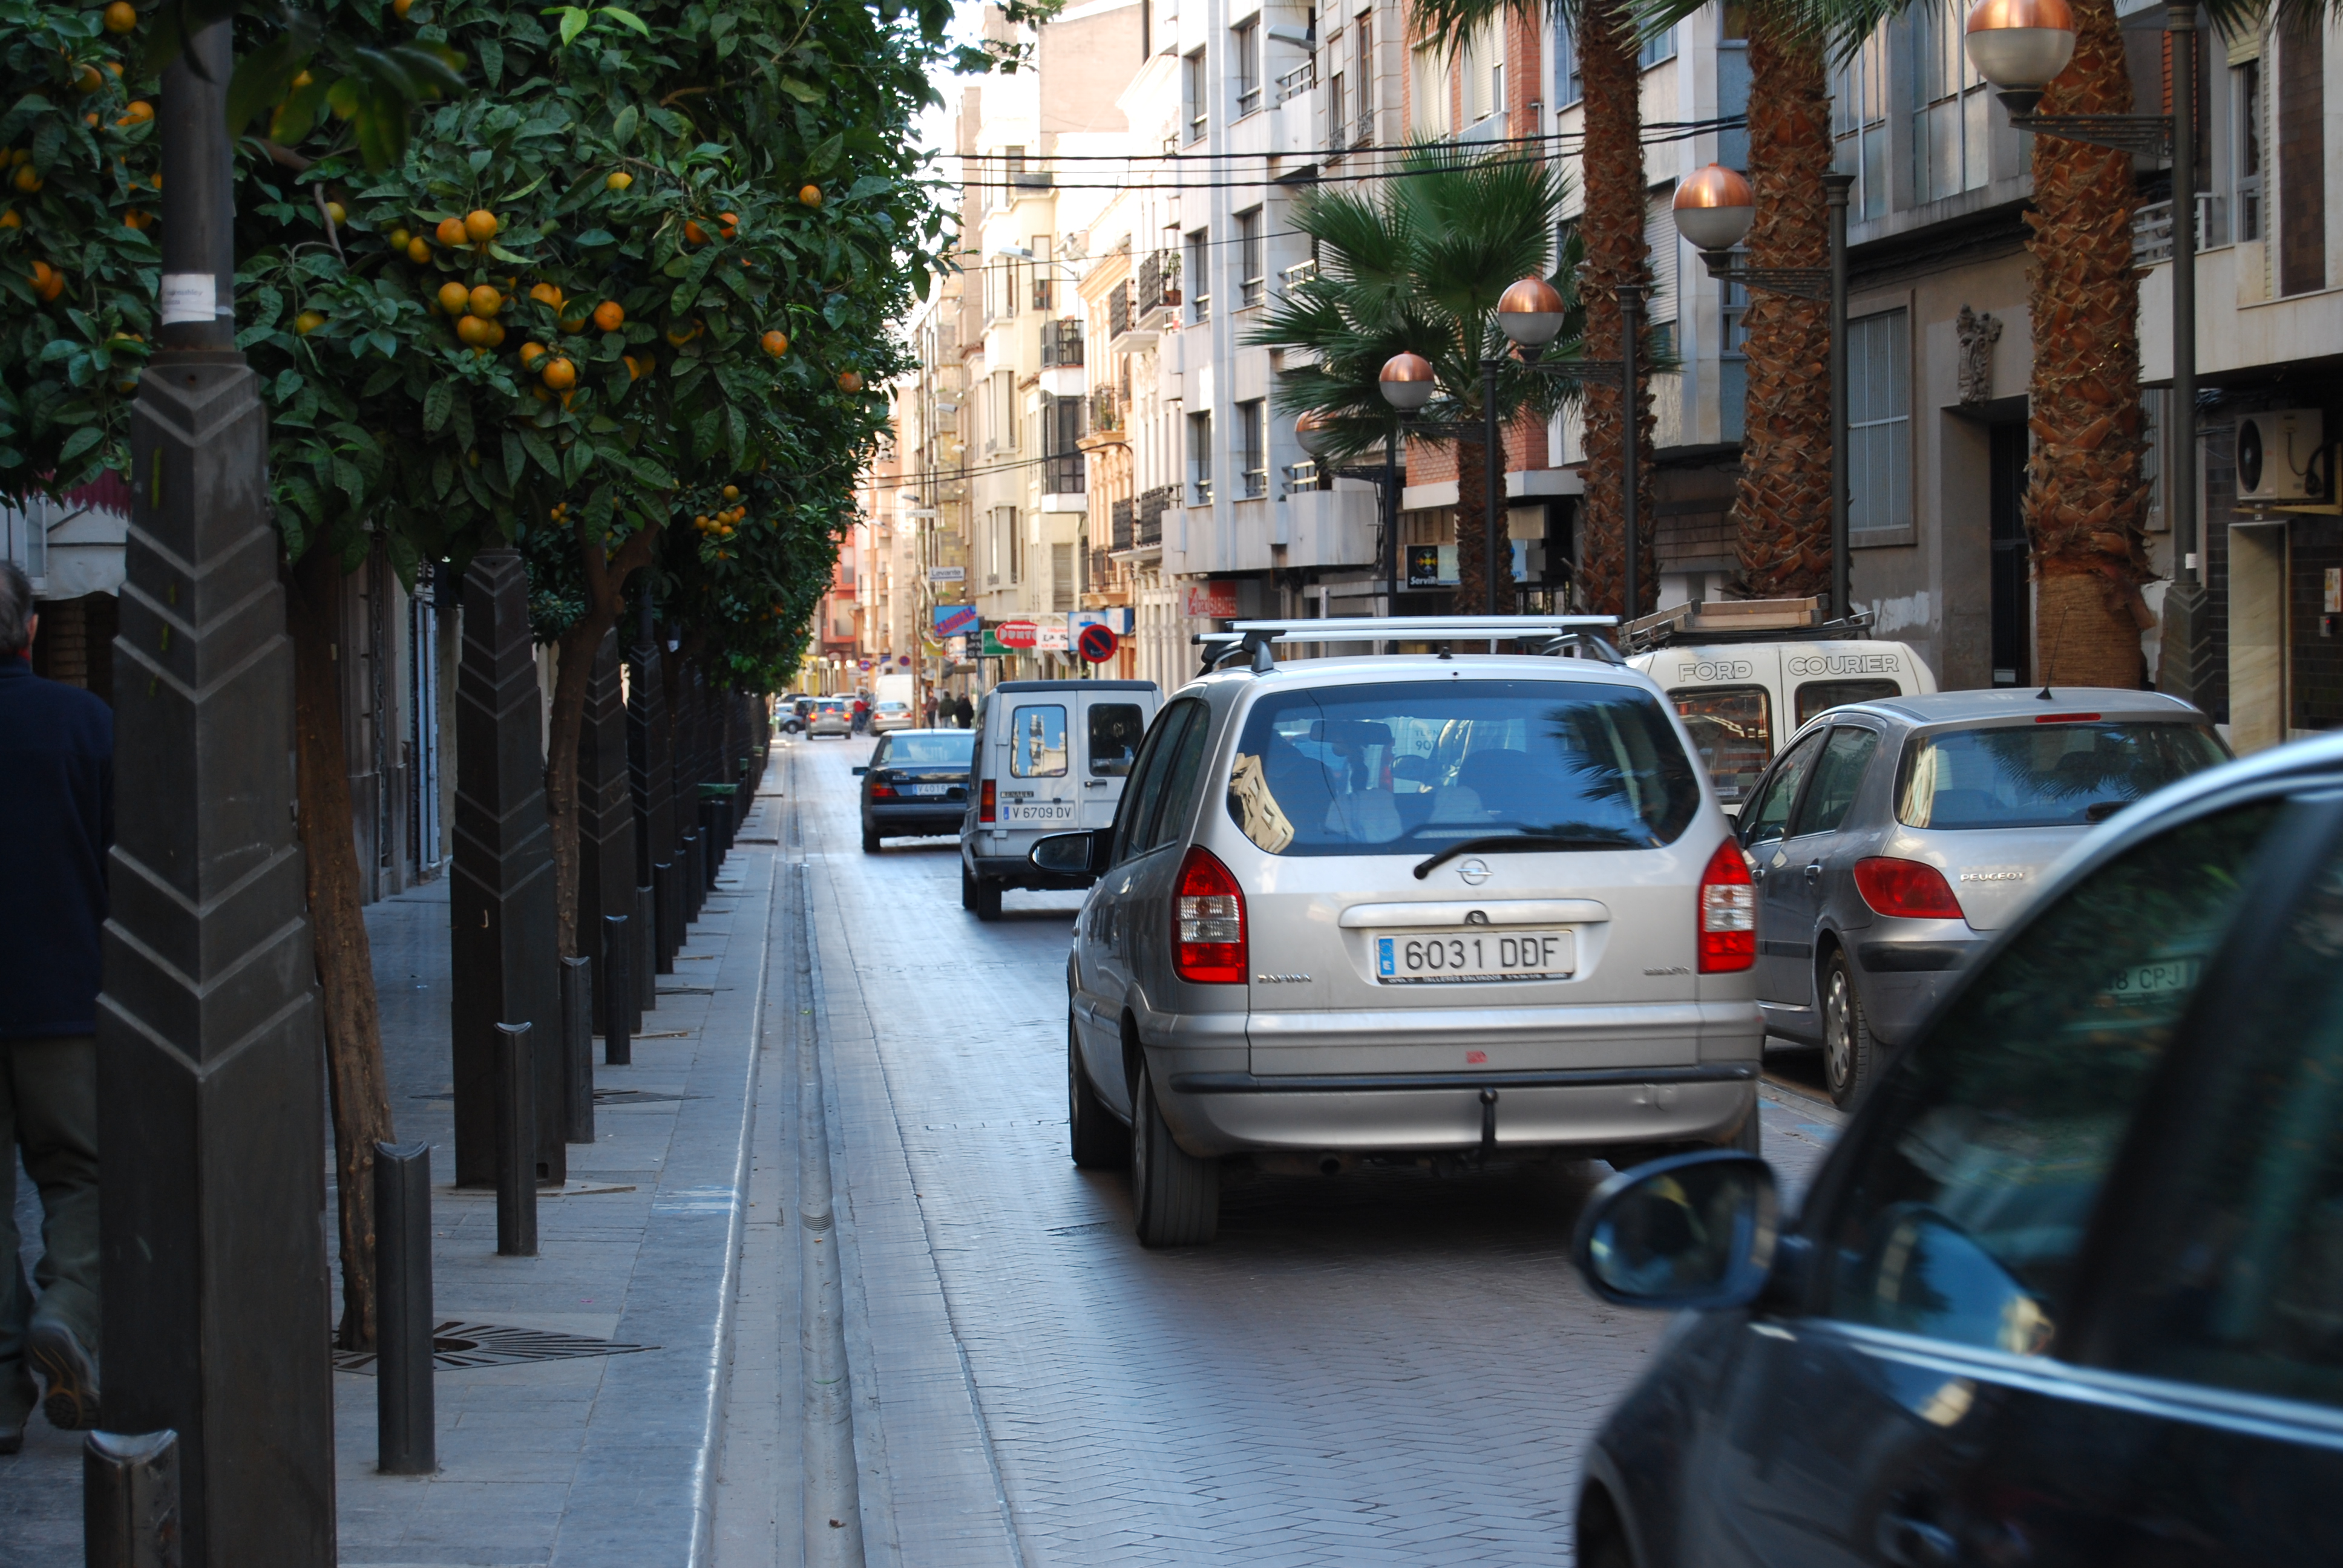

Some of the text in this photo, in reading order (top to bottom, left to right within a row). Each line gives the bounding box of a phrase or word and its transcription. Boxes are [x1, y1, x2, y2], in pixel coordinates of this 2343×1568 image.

[1679, 661, 1752, 682] FORD
[1788, 654, 1899, 676] COURIER
[1012, 807, 1071, 818] V 6709 DV
[1961, 872, 2025, 882] PEUGEOT
[1405, 939, 1483, 970] 6031
[1500, 937, 1560, 969] DDF
